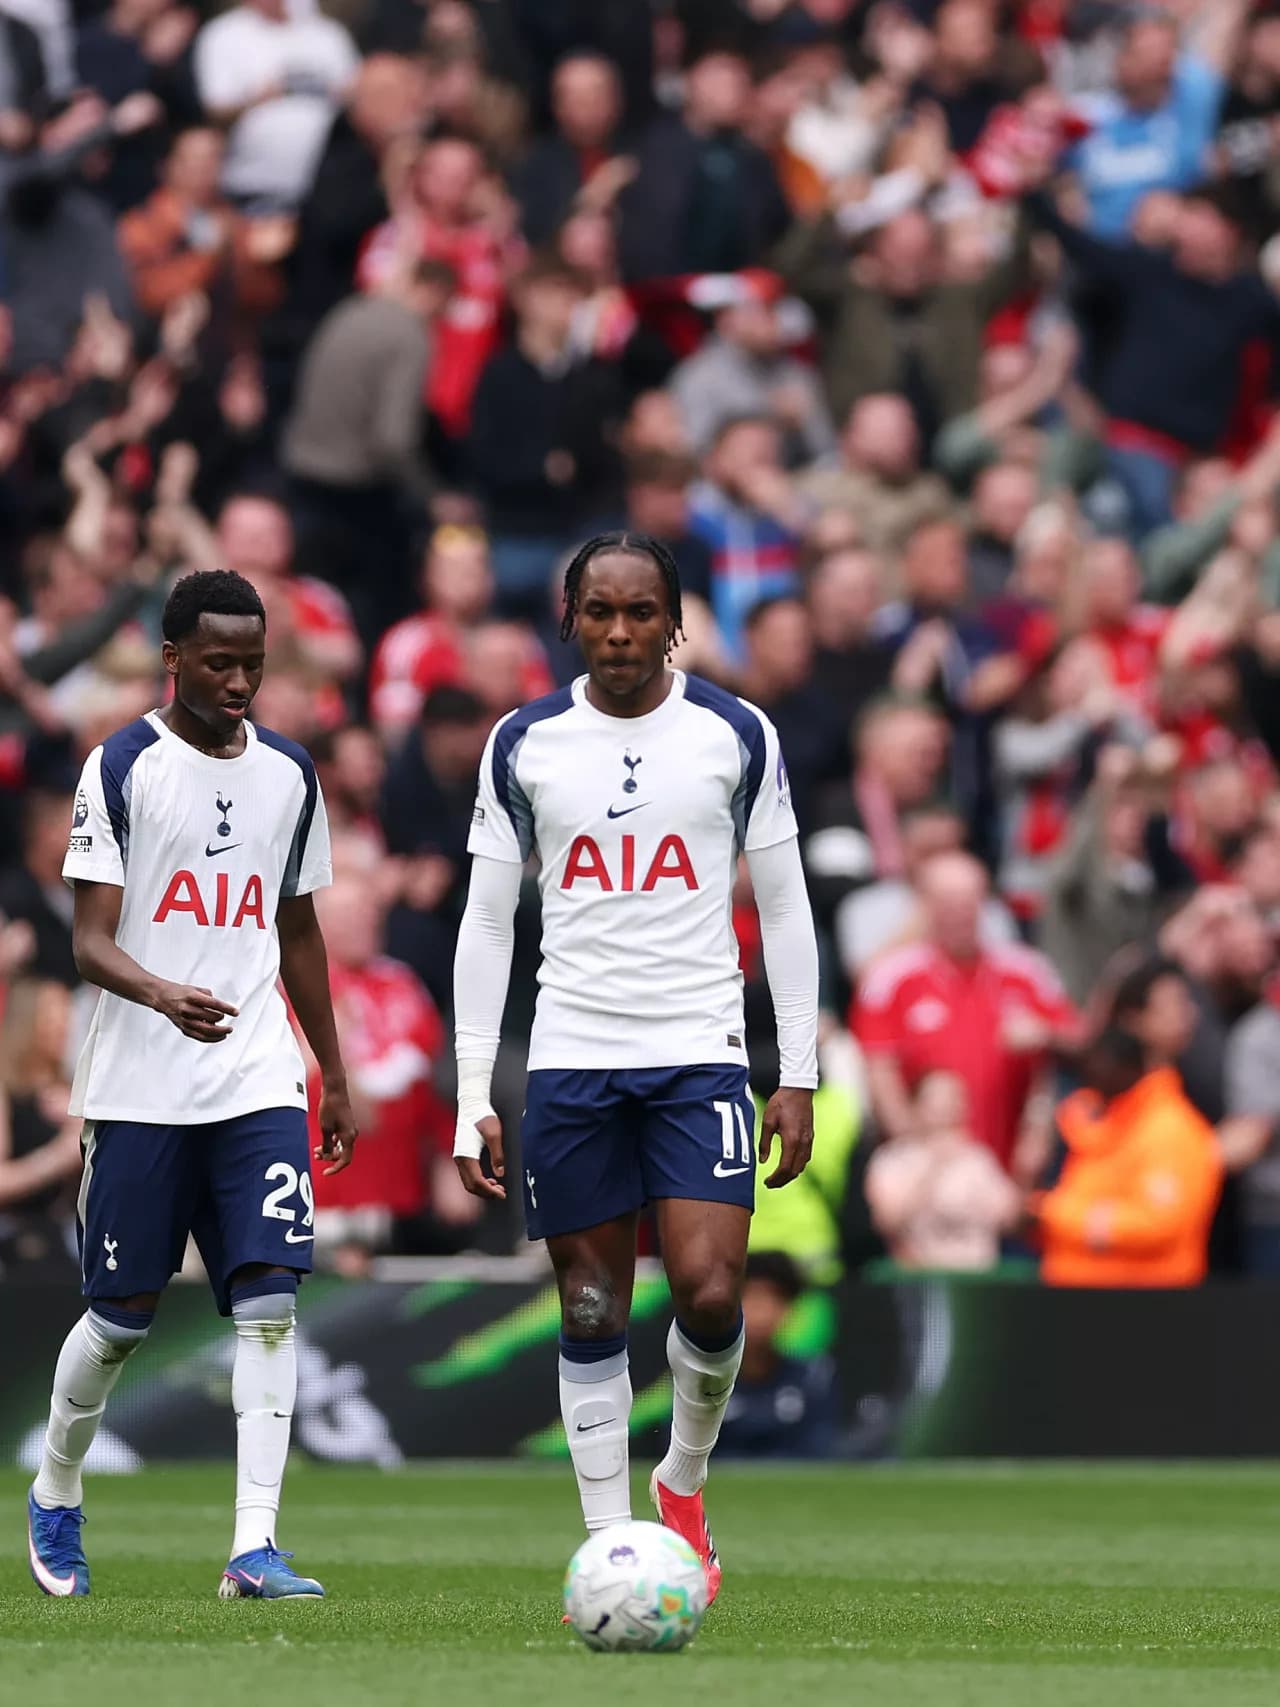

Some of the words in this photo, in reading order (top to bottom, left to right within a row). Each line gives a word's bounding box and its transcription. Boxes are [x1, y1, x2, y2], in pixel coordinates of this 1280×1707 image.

[68, 837, 88, 845] oom
[560, 833, 699, 892] AIA
[152, 869, 266, 929] AIA
[712, 1100, 750, 1164] 11
[261, 1162, 314, 1227] 29
